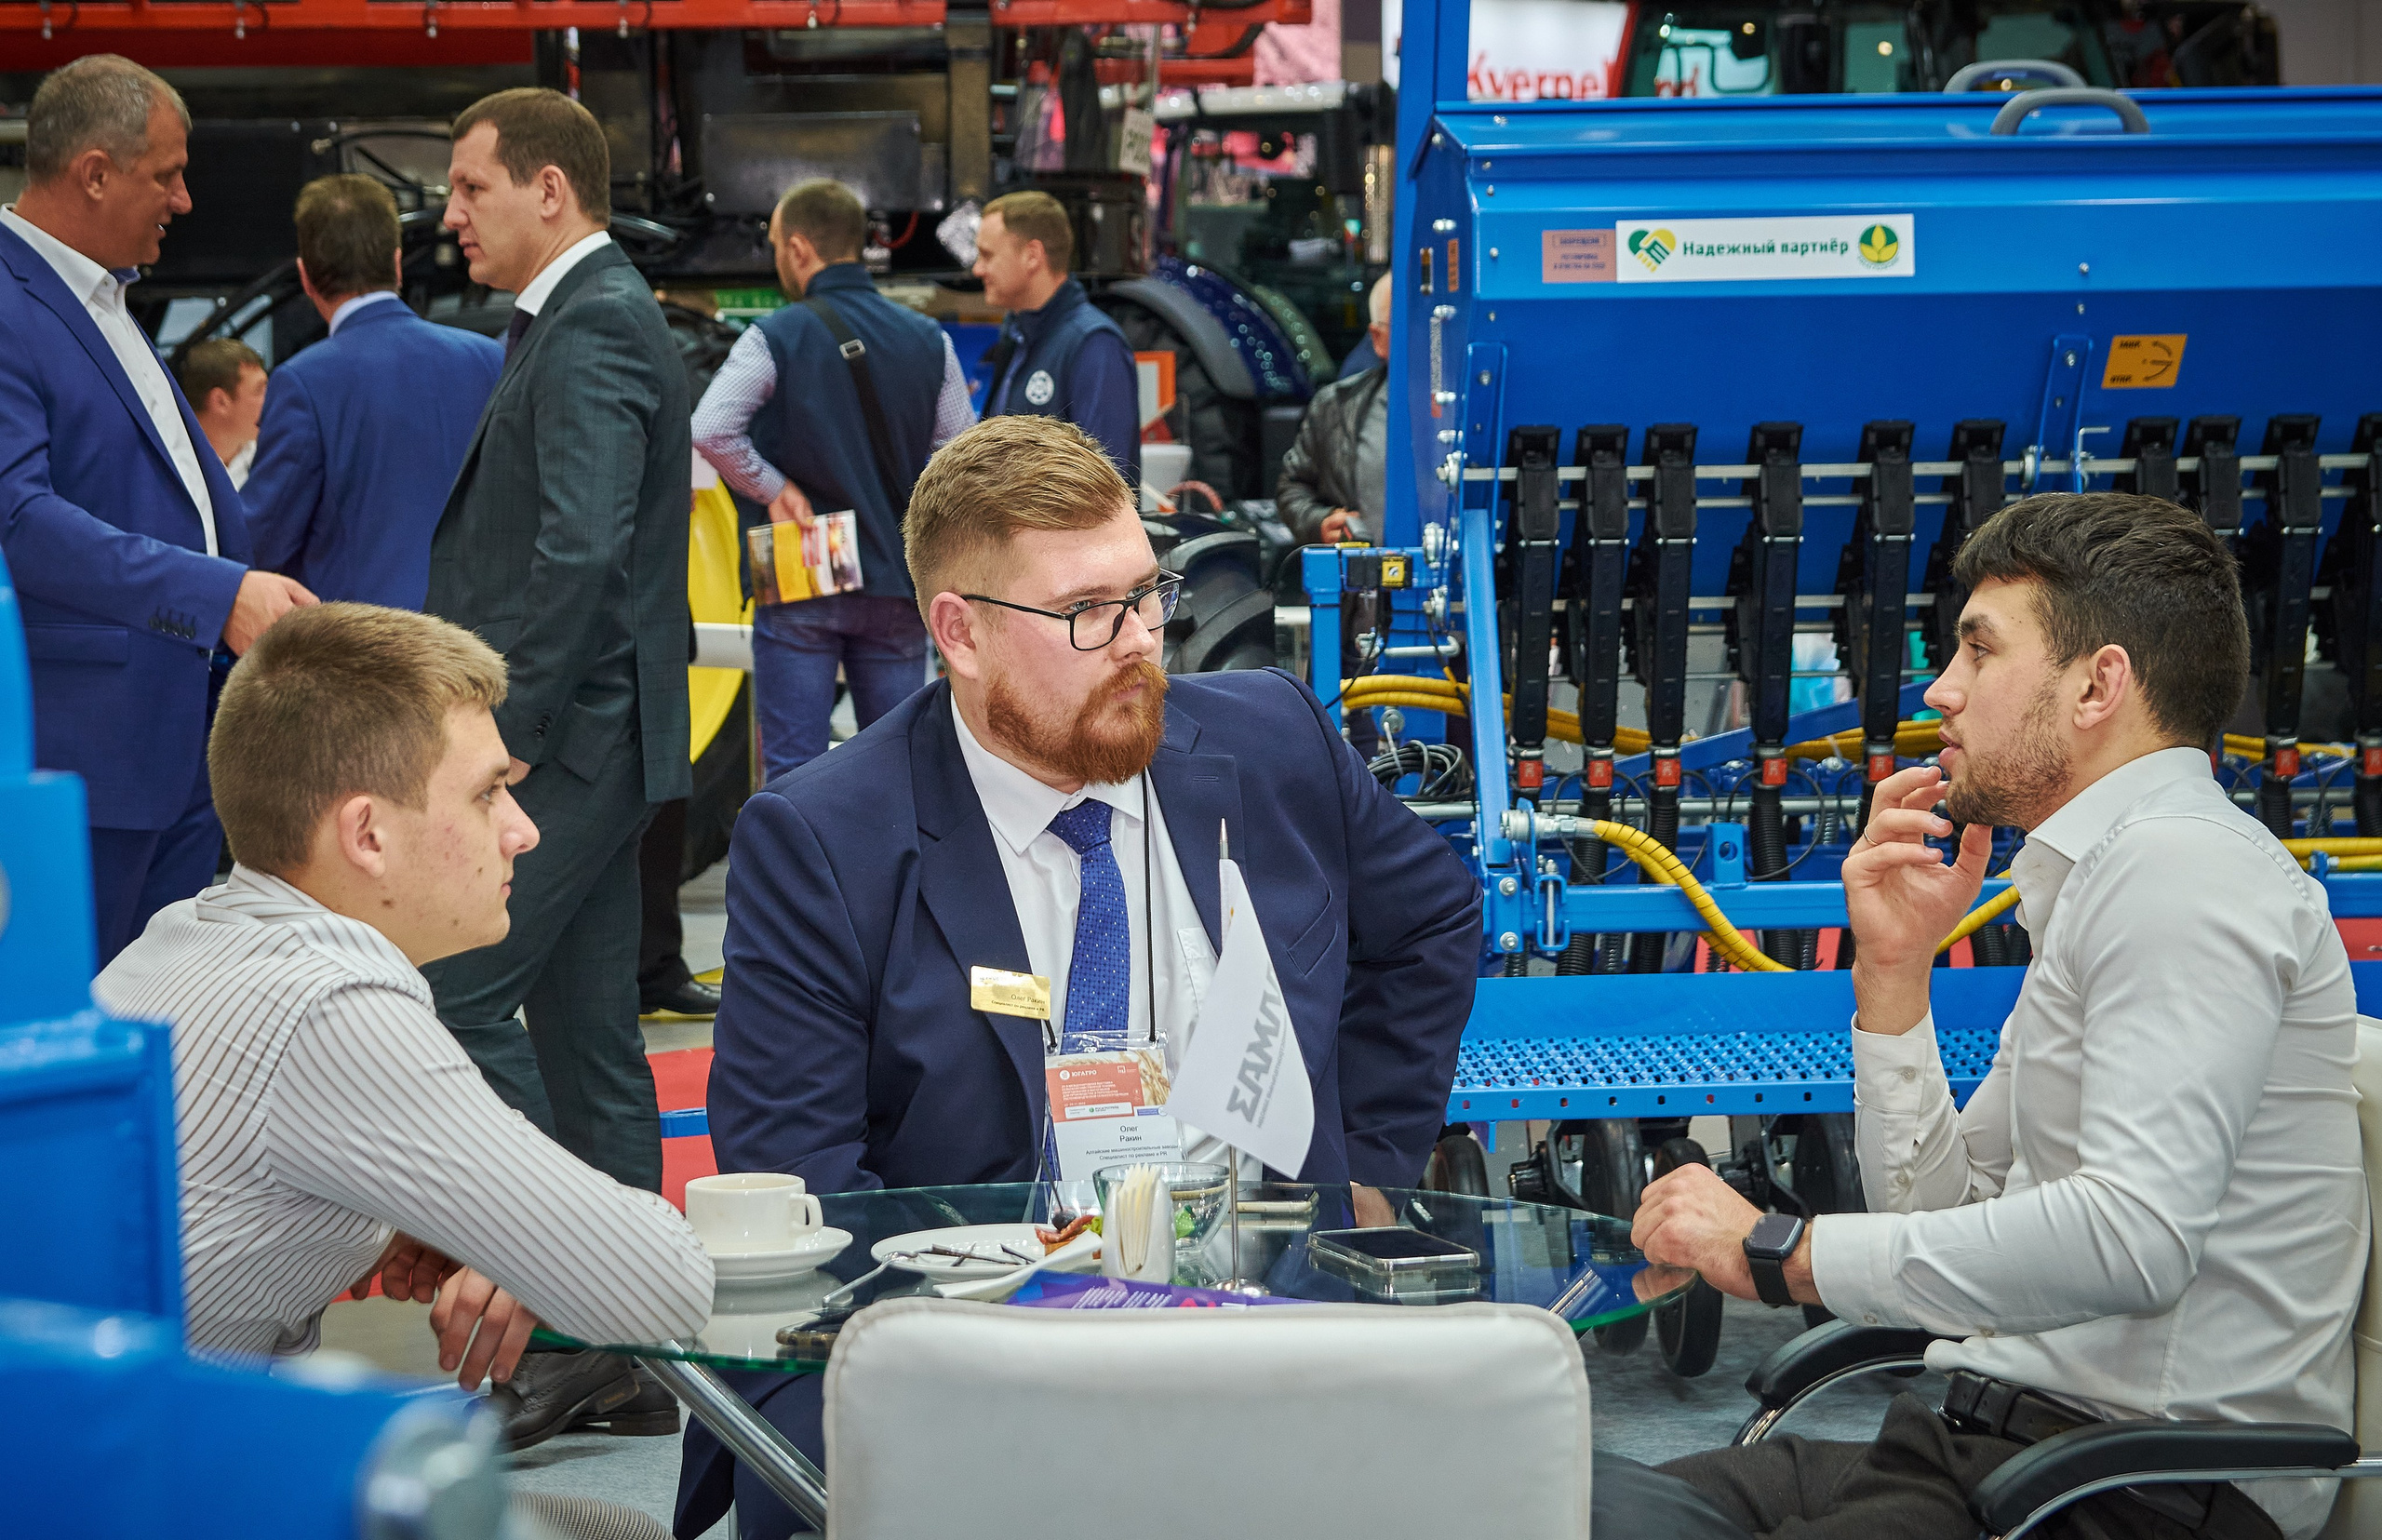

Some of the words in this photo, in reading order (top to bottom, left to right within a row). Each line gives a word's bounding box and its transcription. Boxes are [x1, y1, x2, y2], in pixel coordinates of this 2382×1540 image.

[1683, 239, 1775, 257] Надежный
[1781, 237, 1849, 256] партнёр
[1119, 1134, 1143, 1143] Ракин
